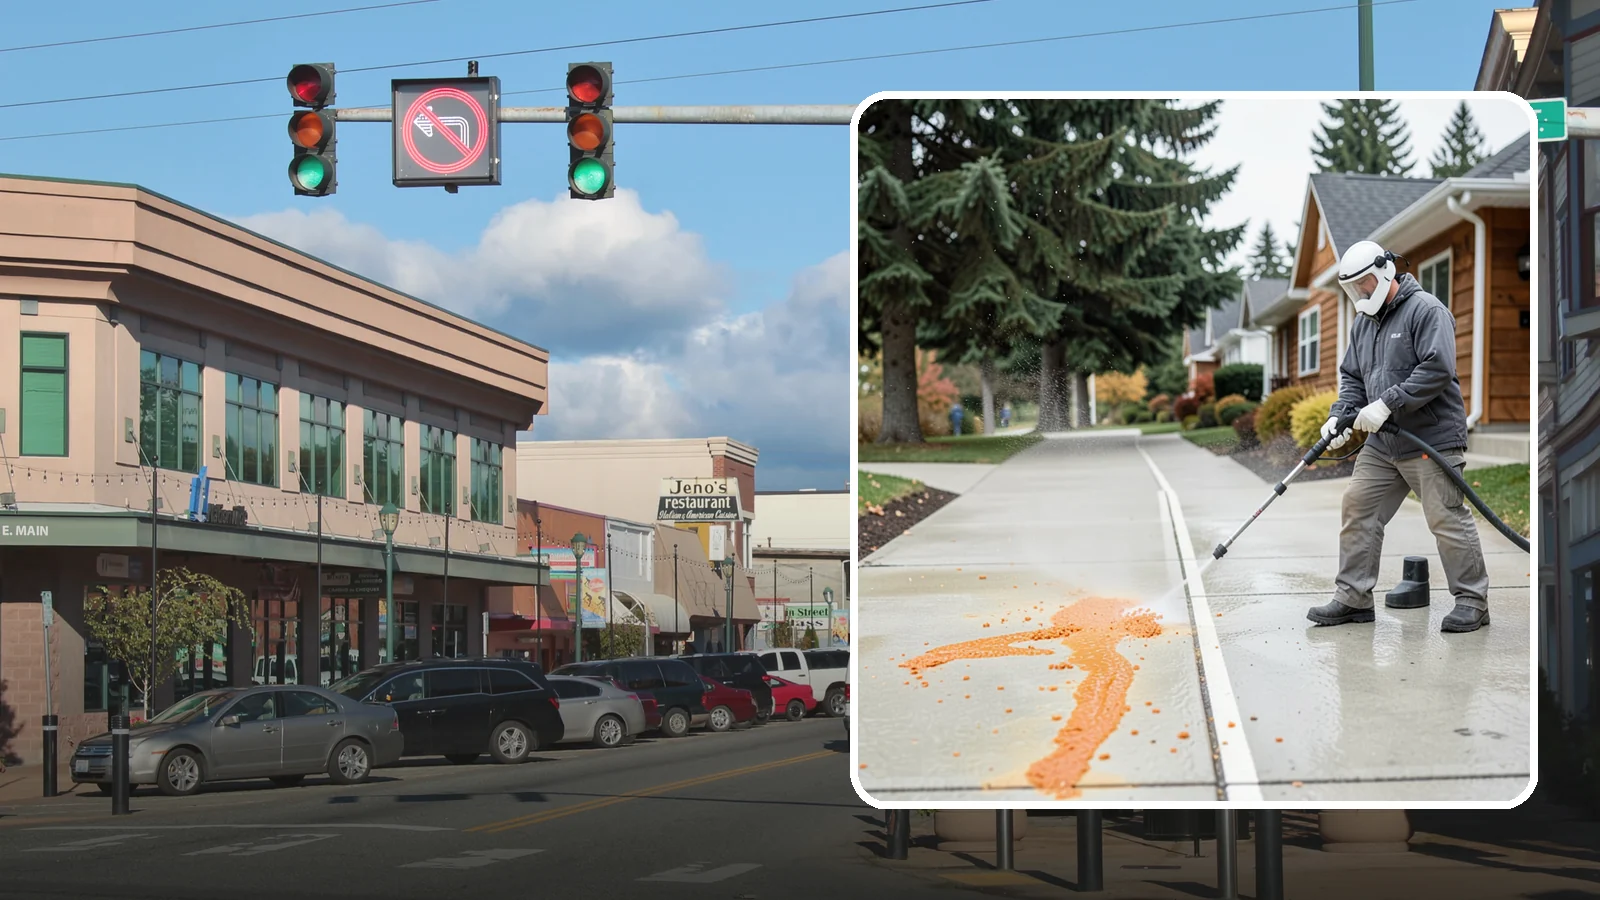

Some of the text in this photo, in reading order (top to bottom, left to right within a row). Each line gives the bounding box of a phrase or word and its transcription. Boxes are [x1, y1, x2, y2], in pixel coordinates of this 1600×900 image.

[669, 480, 728, 494] Jeno's
[665, 496, 731, 509] restaurant
[658, 510, 682, 520] Italian
[686, 509, 715, 520] American
[715, 509, 737, 520] Cuisine
[2, 525, 49, 536] E. MAIN
[797, 607, 829, 617] Street
[790, 619, 824, 627] lass
